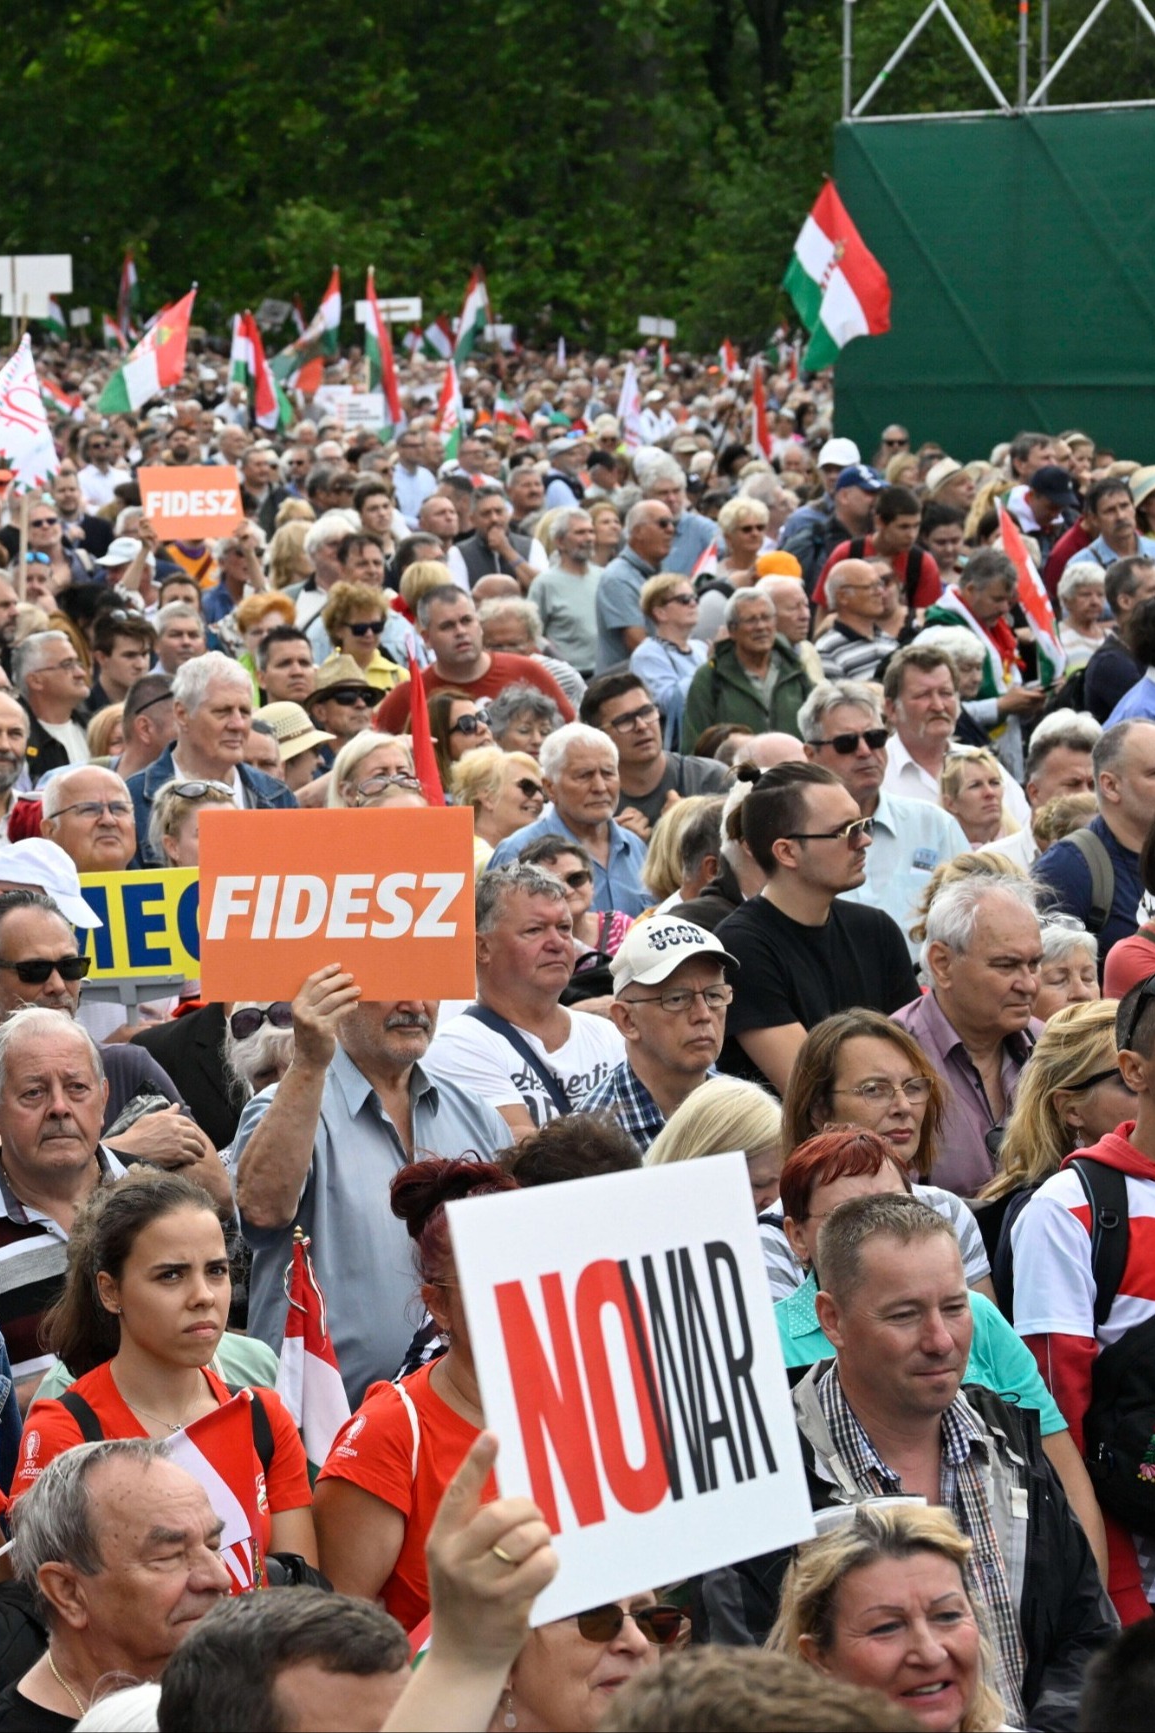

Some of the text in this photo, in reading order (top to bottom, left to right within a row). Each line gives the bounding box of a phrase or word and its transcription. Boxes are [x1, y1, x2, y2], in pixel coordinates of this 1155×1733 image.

[146, 489, 237, 518] FIDESZ
[206, 872, 465, 940] FIDESZ
[493, 1240, 778, 1535] NO WAR
